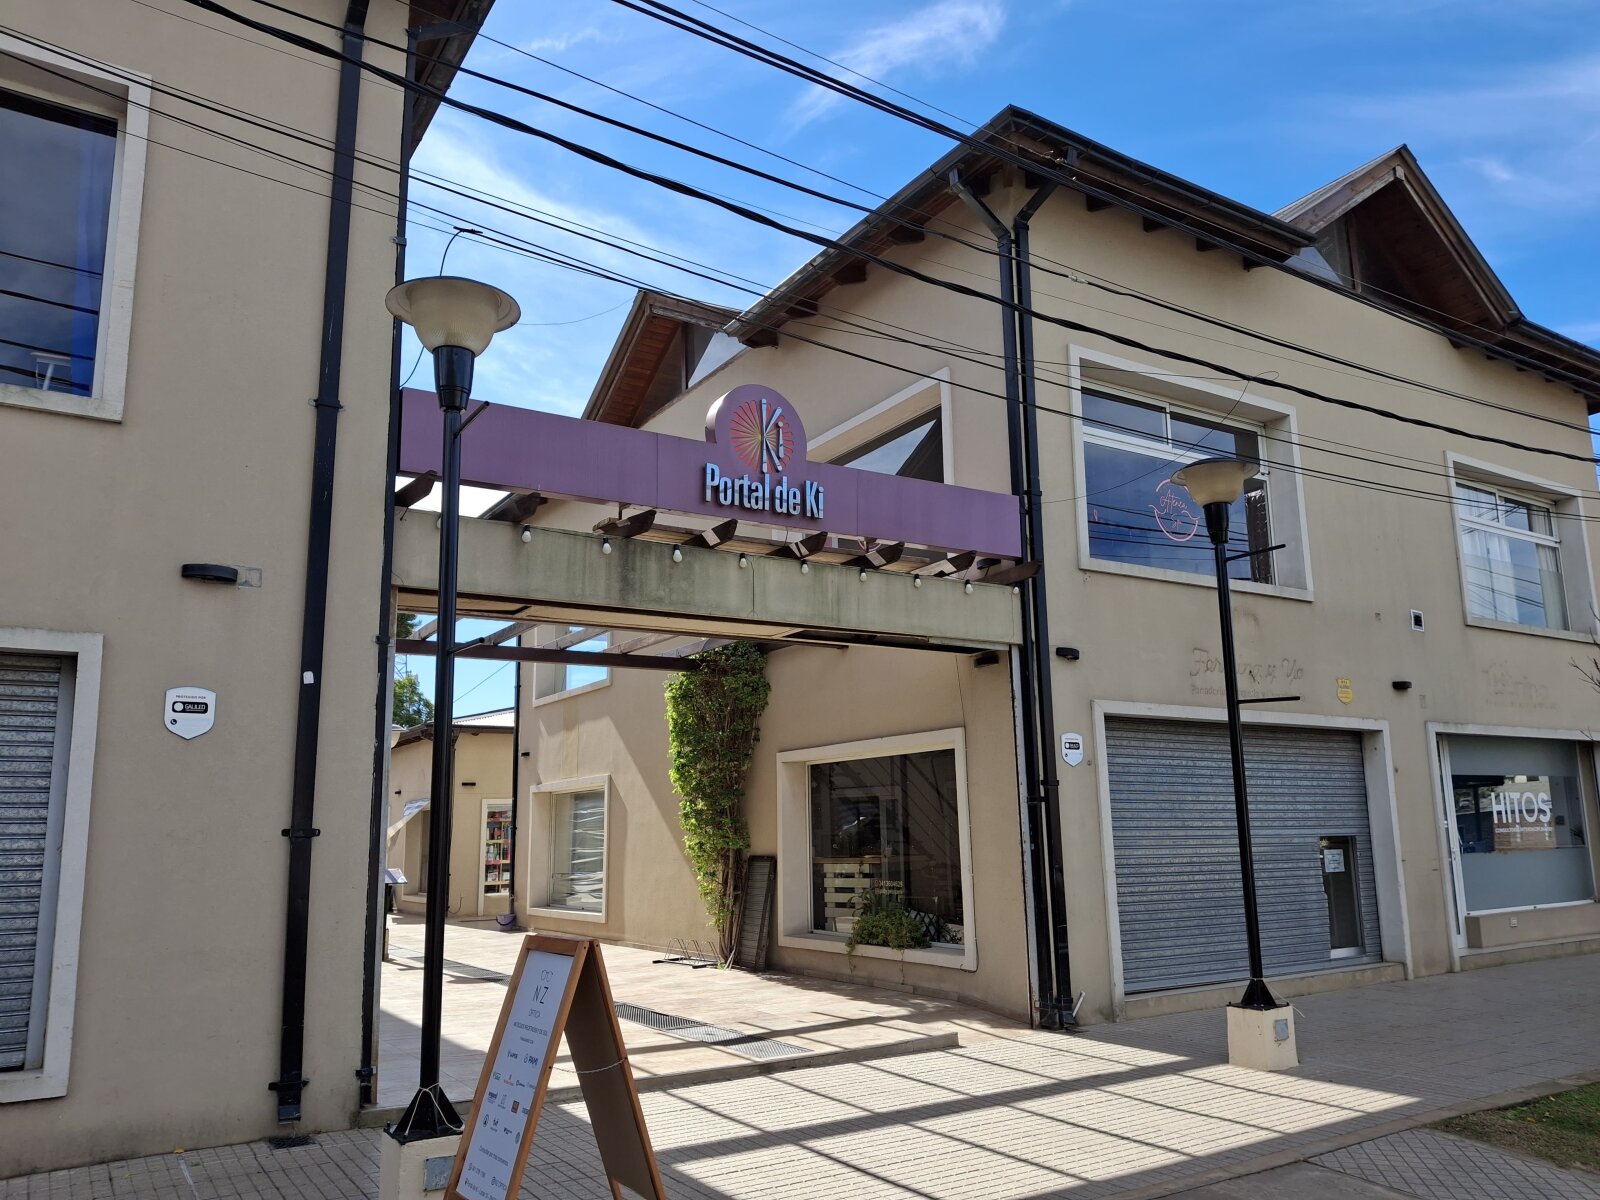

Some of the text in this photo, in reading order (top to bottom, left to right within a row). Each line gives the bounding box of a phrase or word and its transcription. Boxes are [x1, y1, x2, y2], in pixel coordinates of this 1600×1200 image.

[761, 398, 785, 473] Ki
[704, 462, 825, 519] Portal de Ki
[1490, 791, 1551, 824] HITOS
[532, 984, 550, 1005] NZ
